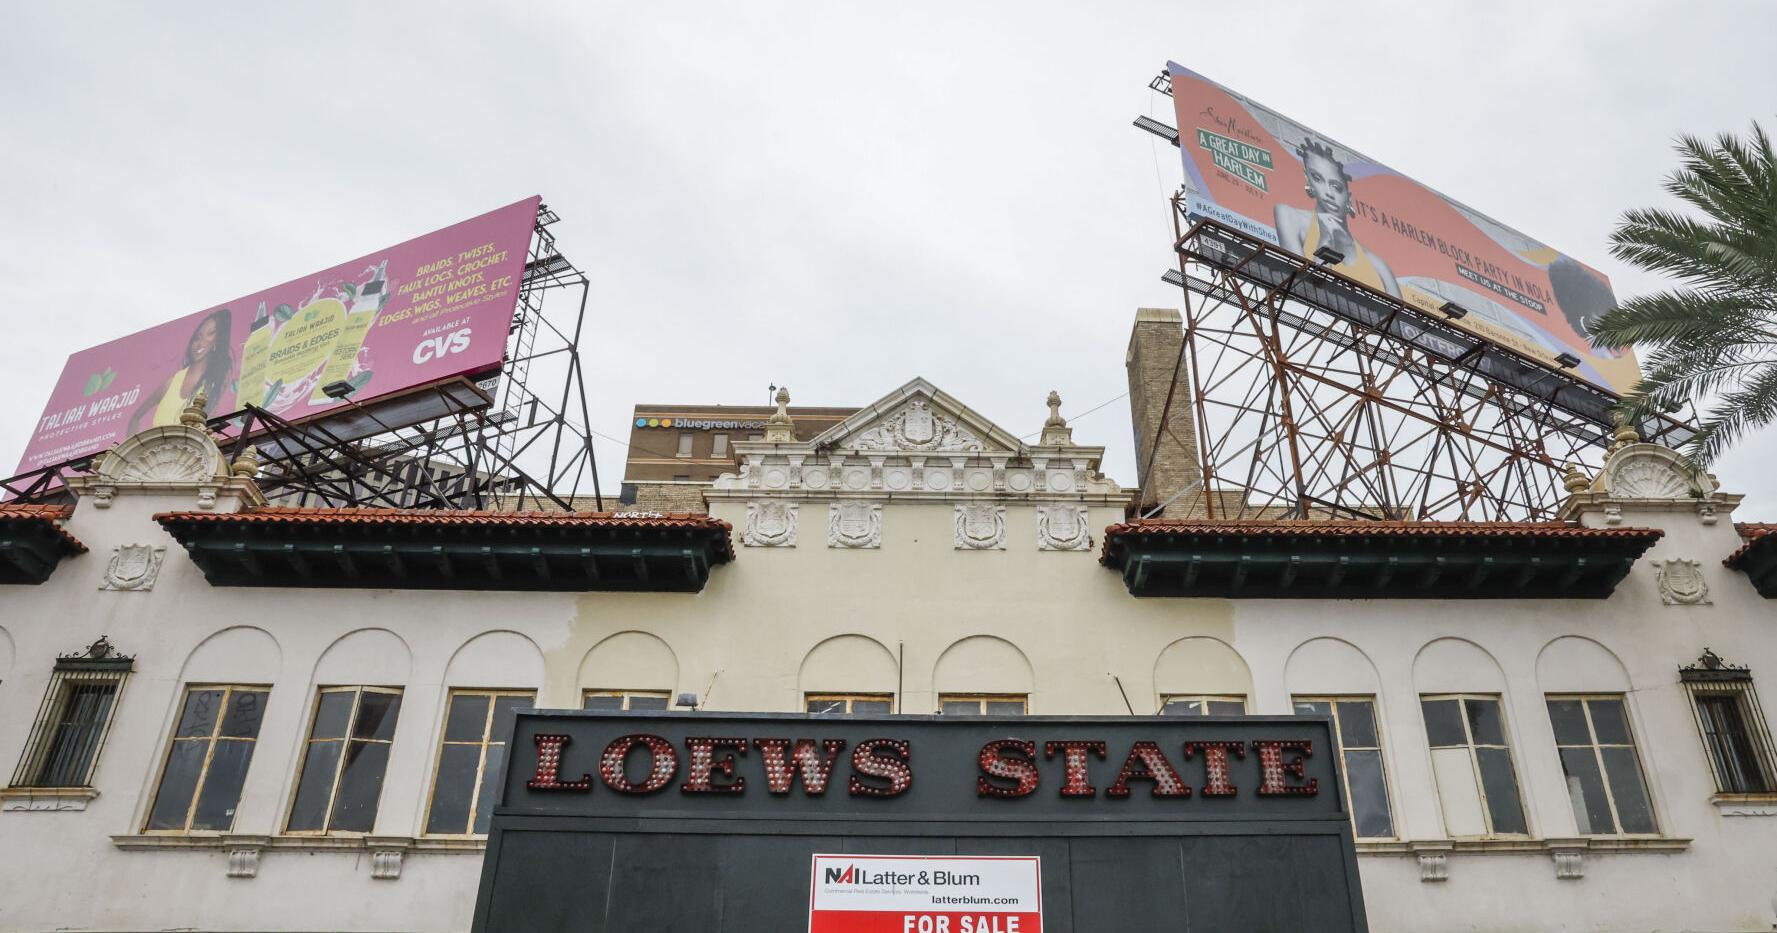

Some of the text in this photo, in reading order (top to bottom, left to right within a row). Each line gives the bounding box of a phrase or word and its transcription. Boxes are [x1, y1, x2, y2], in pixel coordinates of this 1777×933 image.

[1200, 132, 1270, 163] A GREAT DAY IN
[1213, 149, 1266, 189] HARLEM
[1195, 202, 1277, 242] #AGreatDayWithShea
[1355, 199, 1554, 306] IT'S A HARLEM BLOCK PARTY IN NOLA
[397, 278, 424, 296] FAUX
[411, 283, 447, 304] BANTU
[490, 275, 513, 291] ETC.
[1458, 266, 1543, 311] MEET US AT THE STOOP
[422, 316, 471, 337] AVAILABLE AT
[269, 343, 301, 361] BRAIDS
[301, 339, 309, 350] &
[310, 328, 341, 347] EDGES
[412, 327, 472, 365] CVS
[1404, 325, 1480, 364] OUTFR
[39, 388, 140, 433] TALIAH WAAJID
[39, 412, 122, 440] PROTECTIVE STYLES
[674, 418, 769, 431] bluegreenvaca
[526, 733, 1319, 799] LOEWS STATE
[825, 863, 980, 886] NAI Latter & Blum
[931, 895, 1019, 905] latterblum.com
[903, 914, 1020, 933] FOR SALE
